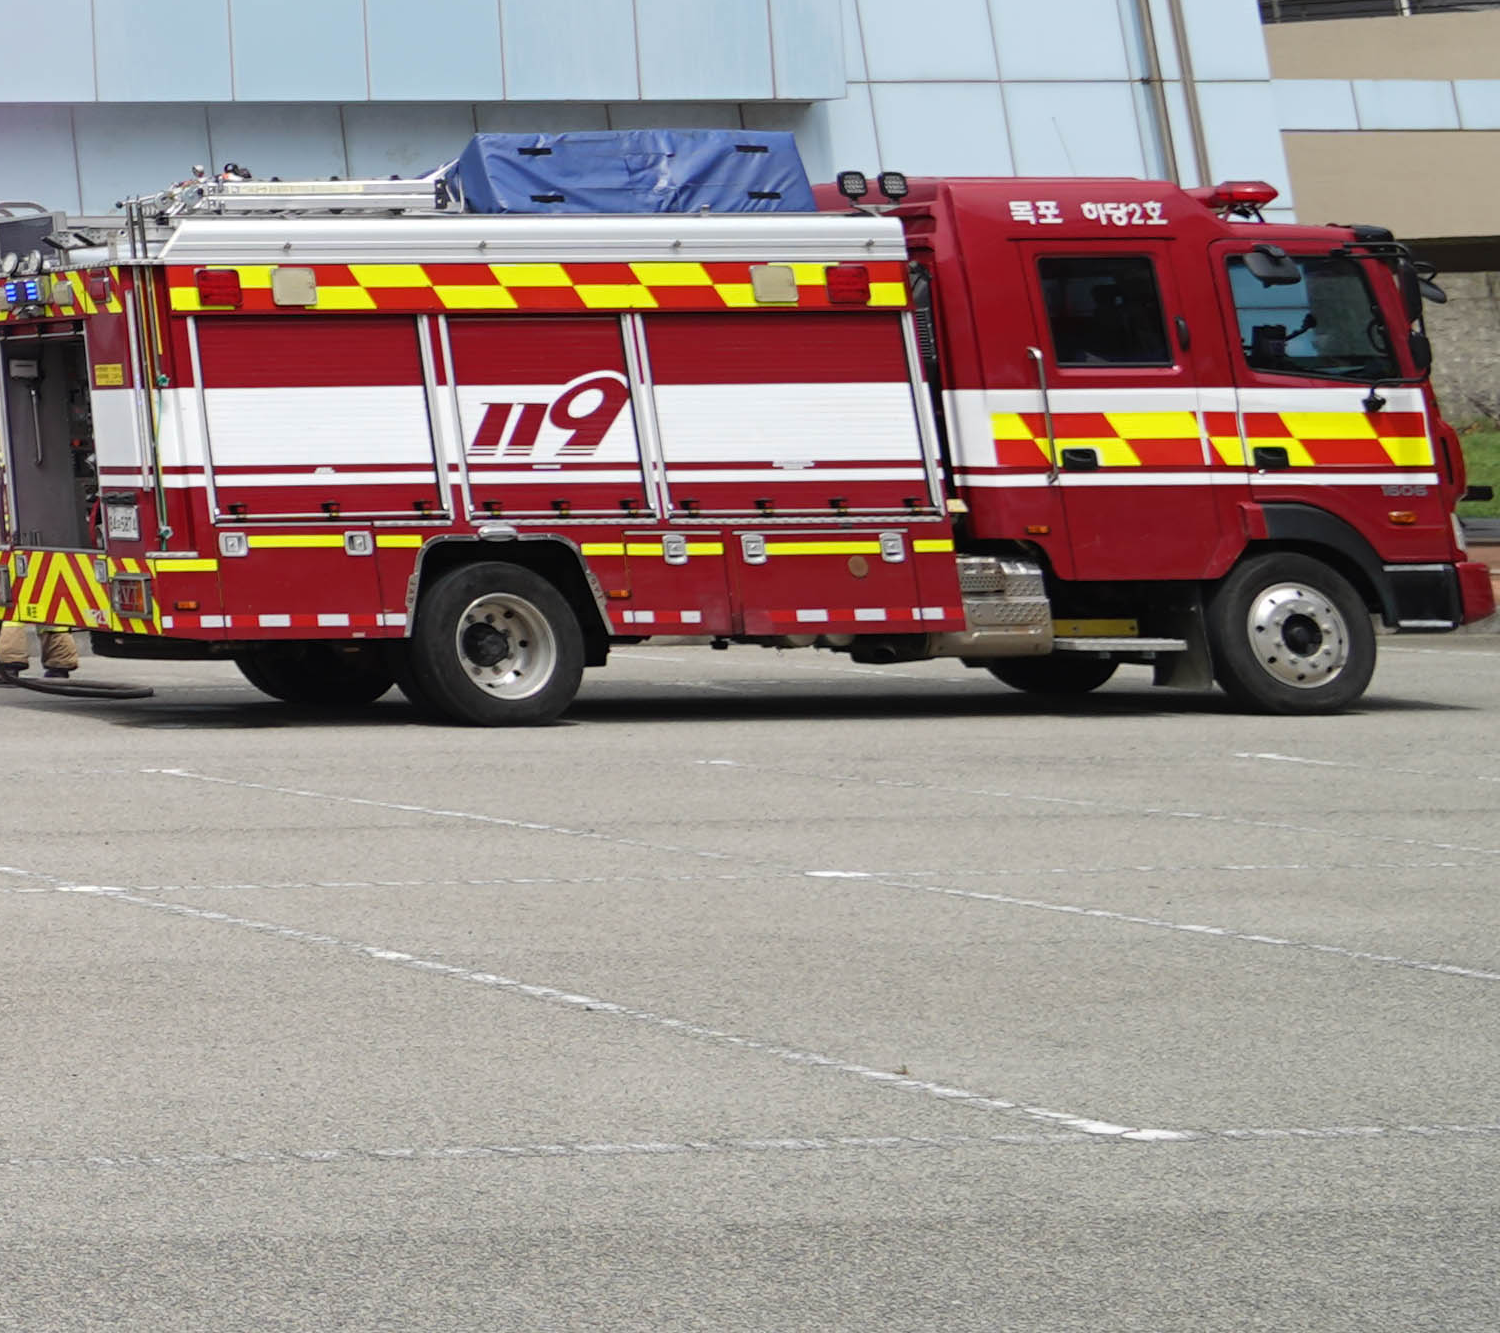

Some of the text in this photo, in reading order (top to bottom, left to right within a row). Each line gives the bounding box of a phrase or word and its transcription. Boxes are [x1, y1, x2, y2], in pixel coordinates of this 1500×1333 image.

[1008, 200, 1169, 226] 목포 하당2호
[466, 376, 631, 457] 119
